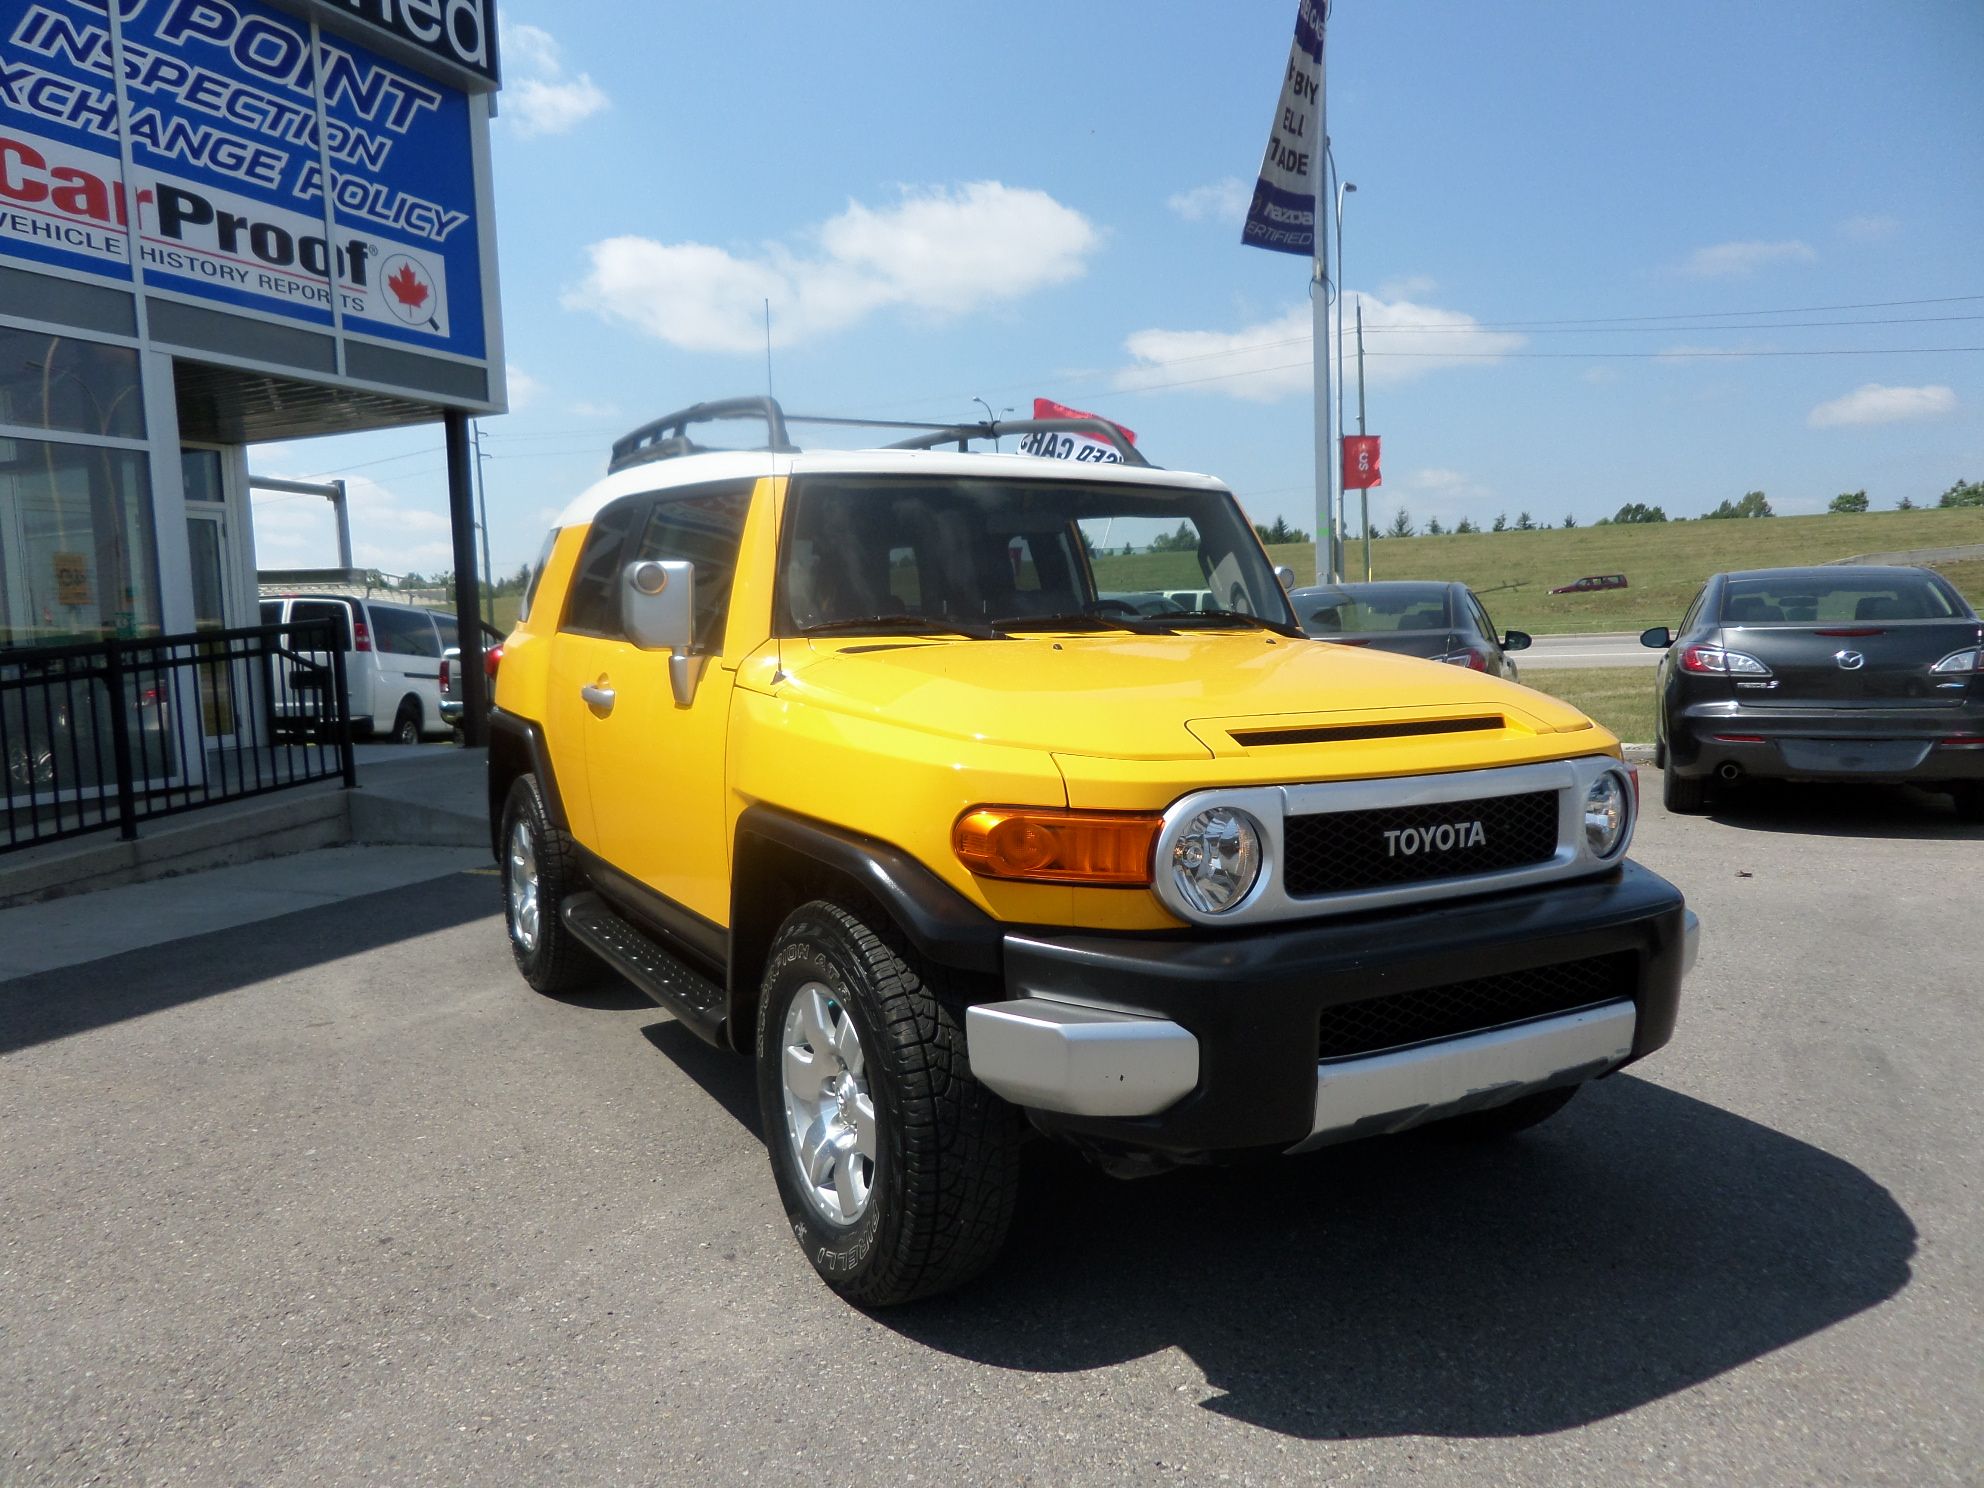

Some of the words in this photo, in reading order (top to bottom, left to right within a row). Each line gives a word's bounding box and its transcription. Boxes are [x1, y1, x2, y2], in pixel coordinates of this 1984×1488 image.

[9, 4, 393, 172] INSPECTION
[155, 0, 442, 134] POINT
[293, 161, 469, 242] POLICY
[140, 245, 249, 284] HISTORY
[259, 274, 365, 313] REPORTS
[1383, 821, 1487, 857] TOYOTA
[817, 1199, 880, 1271] PIRELLI
